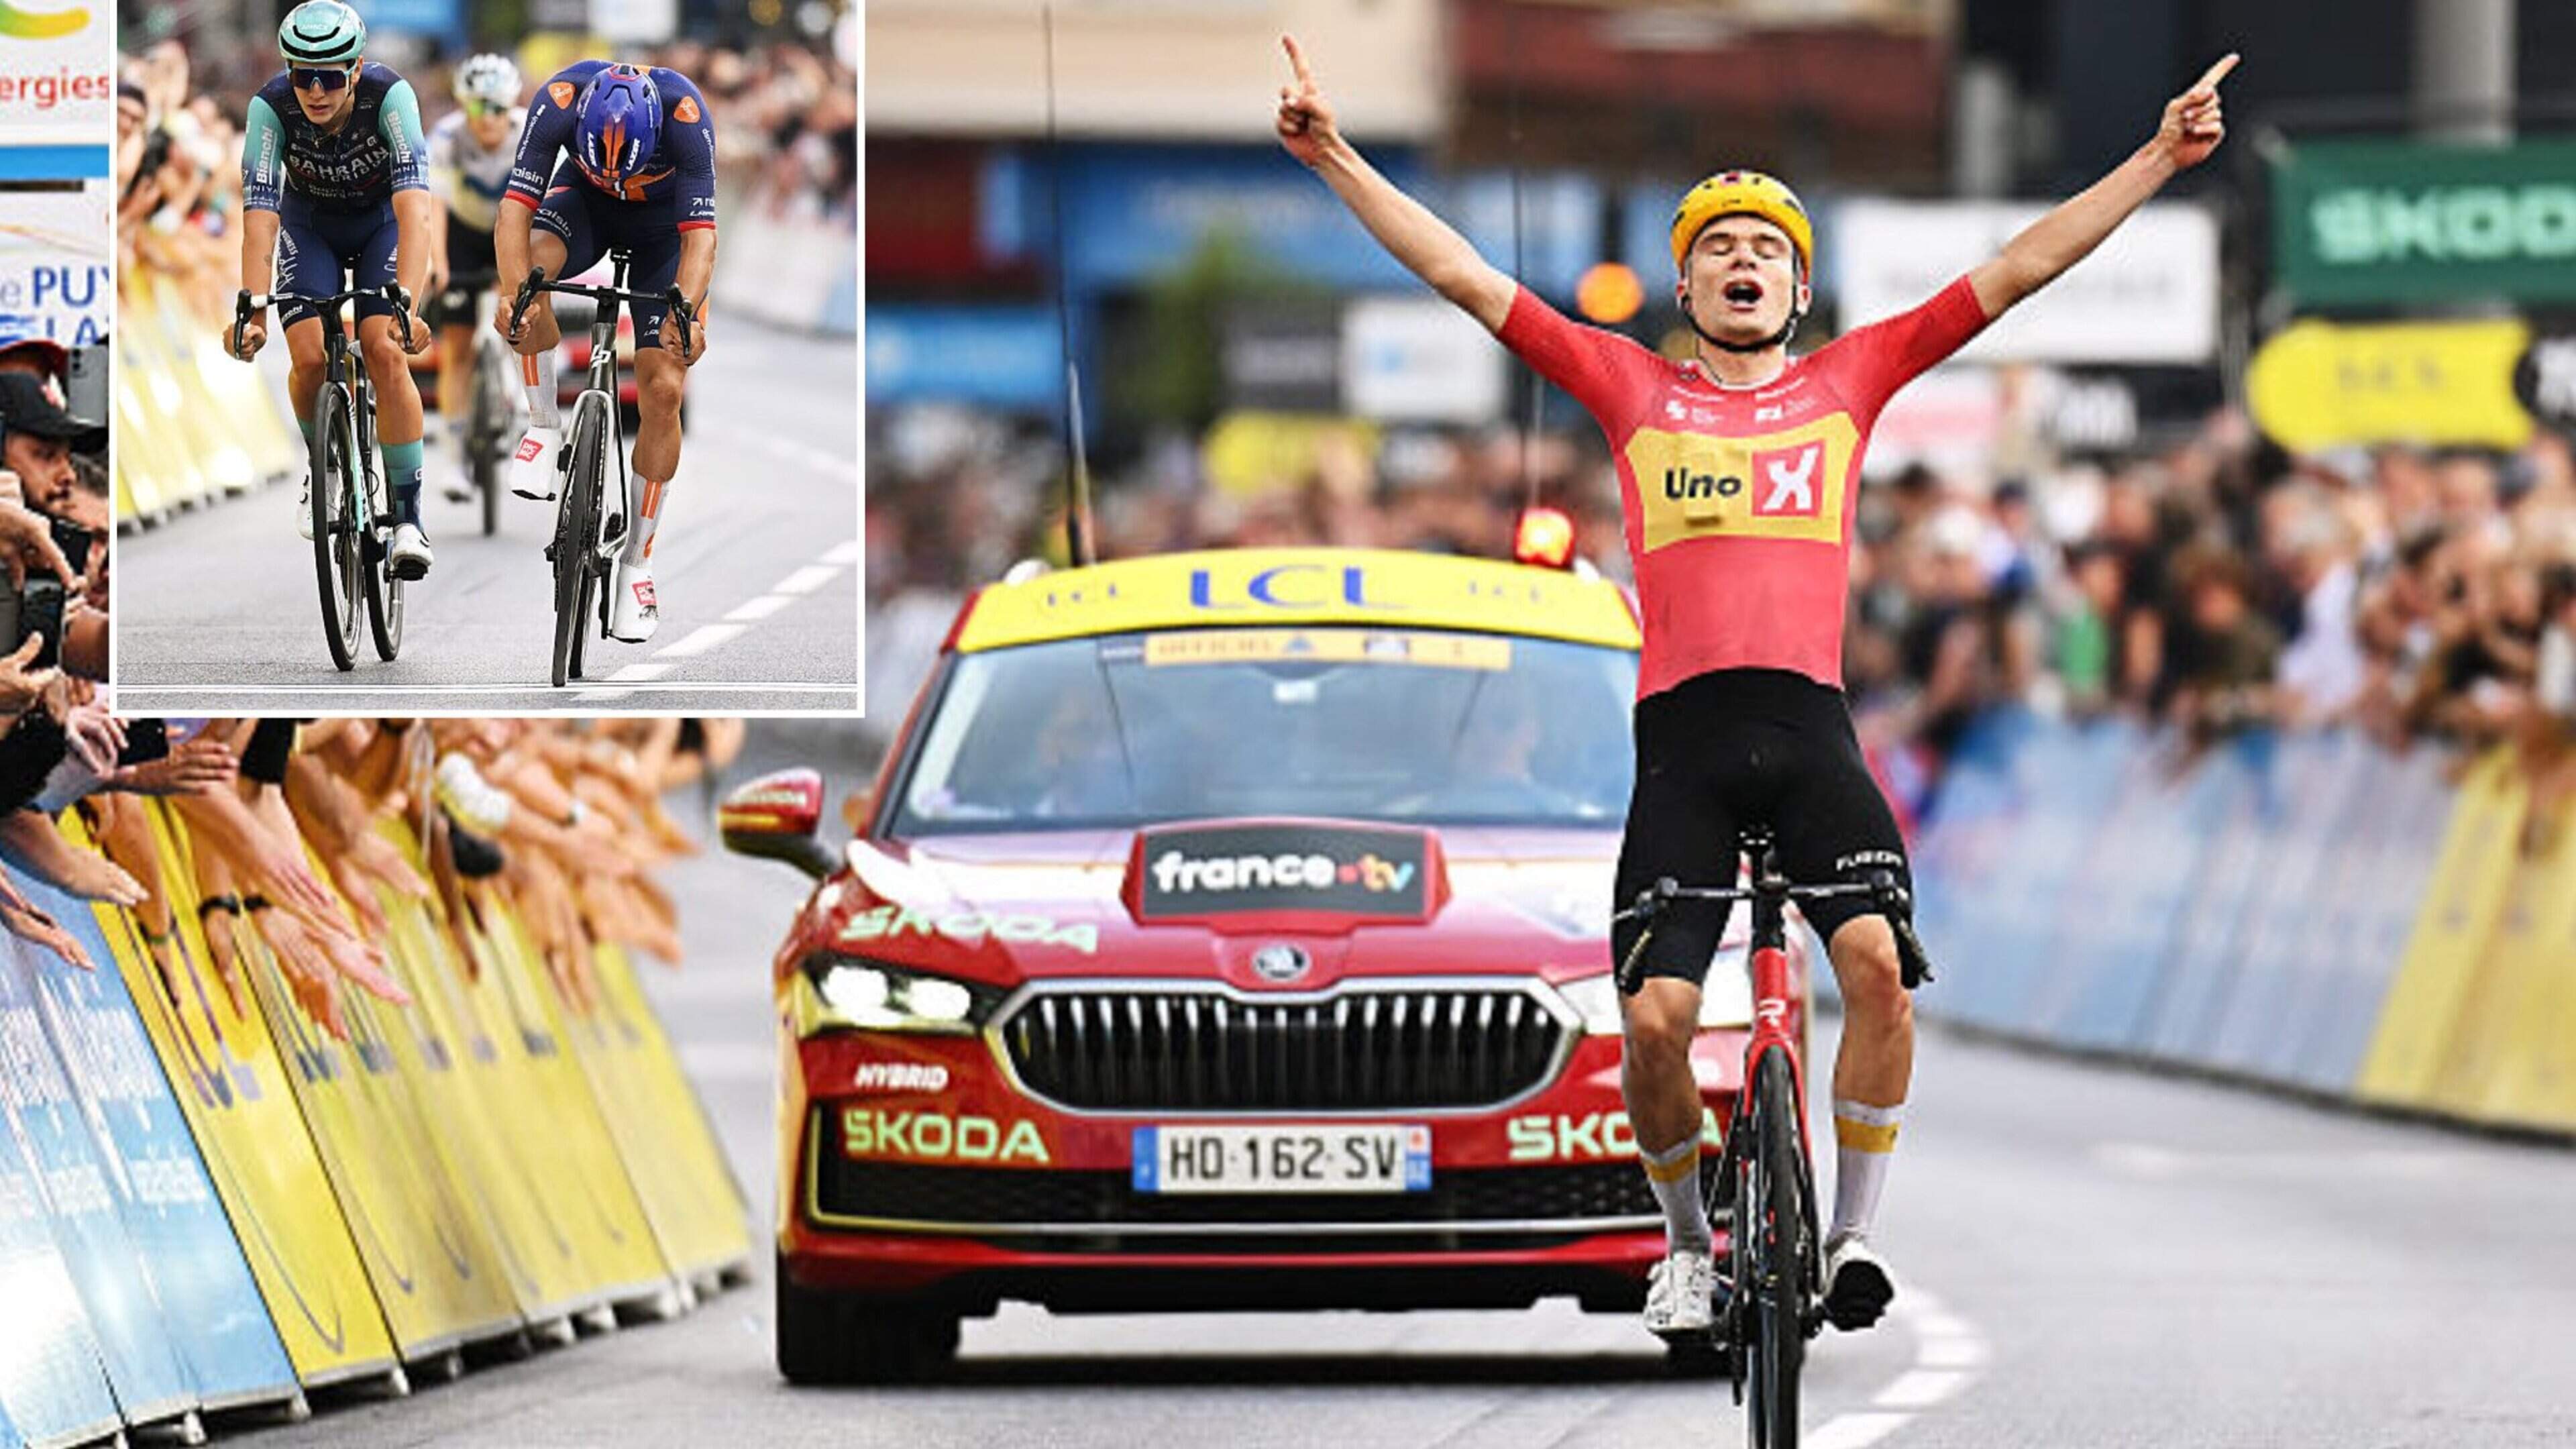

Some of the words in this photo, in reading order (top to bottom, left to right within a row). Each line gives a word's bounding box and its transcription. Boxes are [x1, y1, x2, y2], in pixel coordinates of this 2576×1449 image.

[0, 65, 109, 108] ergies
[256, 125, 273, 184] Bianchi
[289, 146, 389, 177] BAHRAIN
[388, 110, 413, 163] Bianchi
[2312, 182, 2576, 263] SKOD
[1665, 468, 1742, 500] Uno
[1763, 448, 1820, 511] X
[1190, 564, 1407, 608] LCL
[854, 1062, 949, 1092] HYBRID
[1507, 1110, 1722, 1161] SKOA
